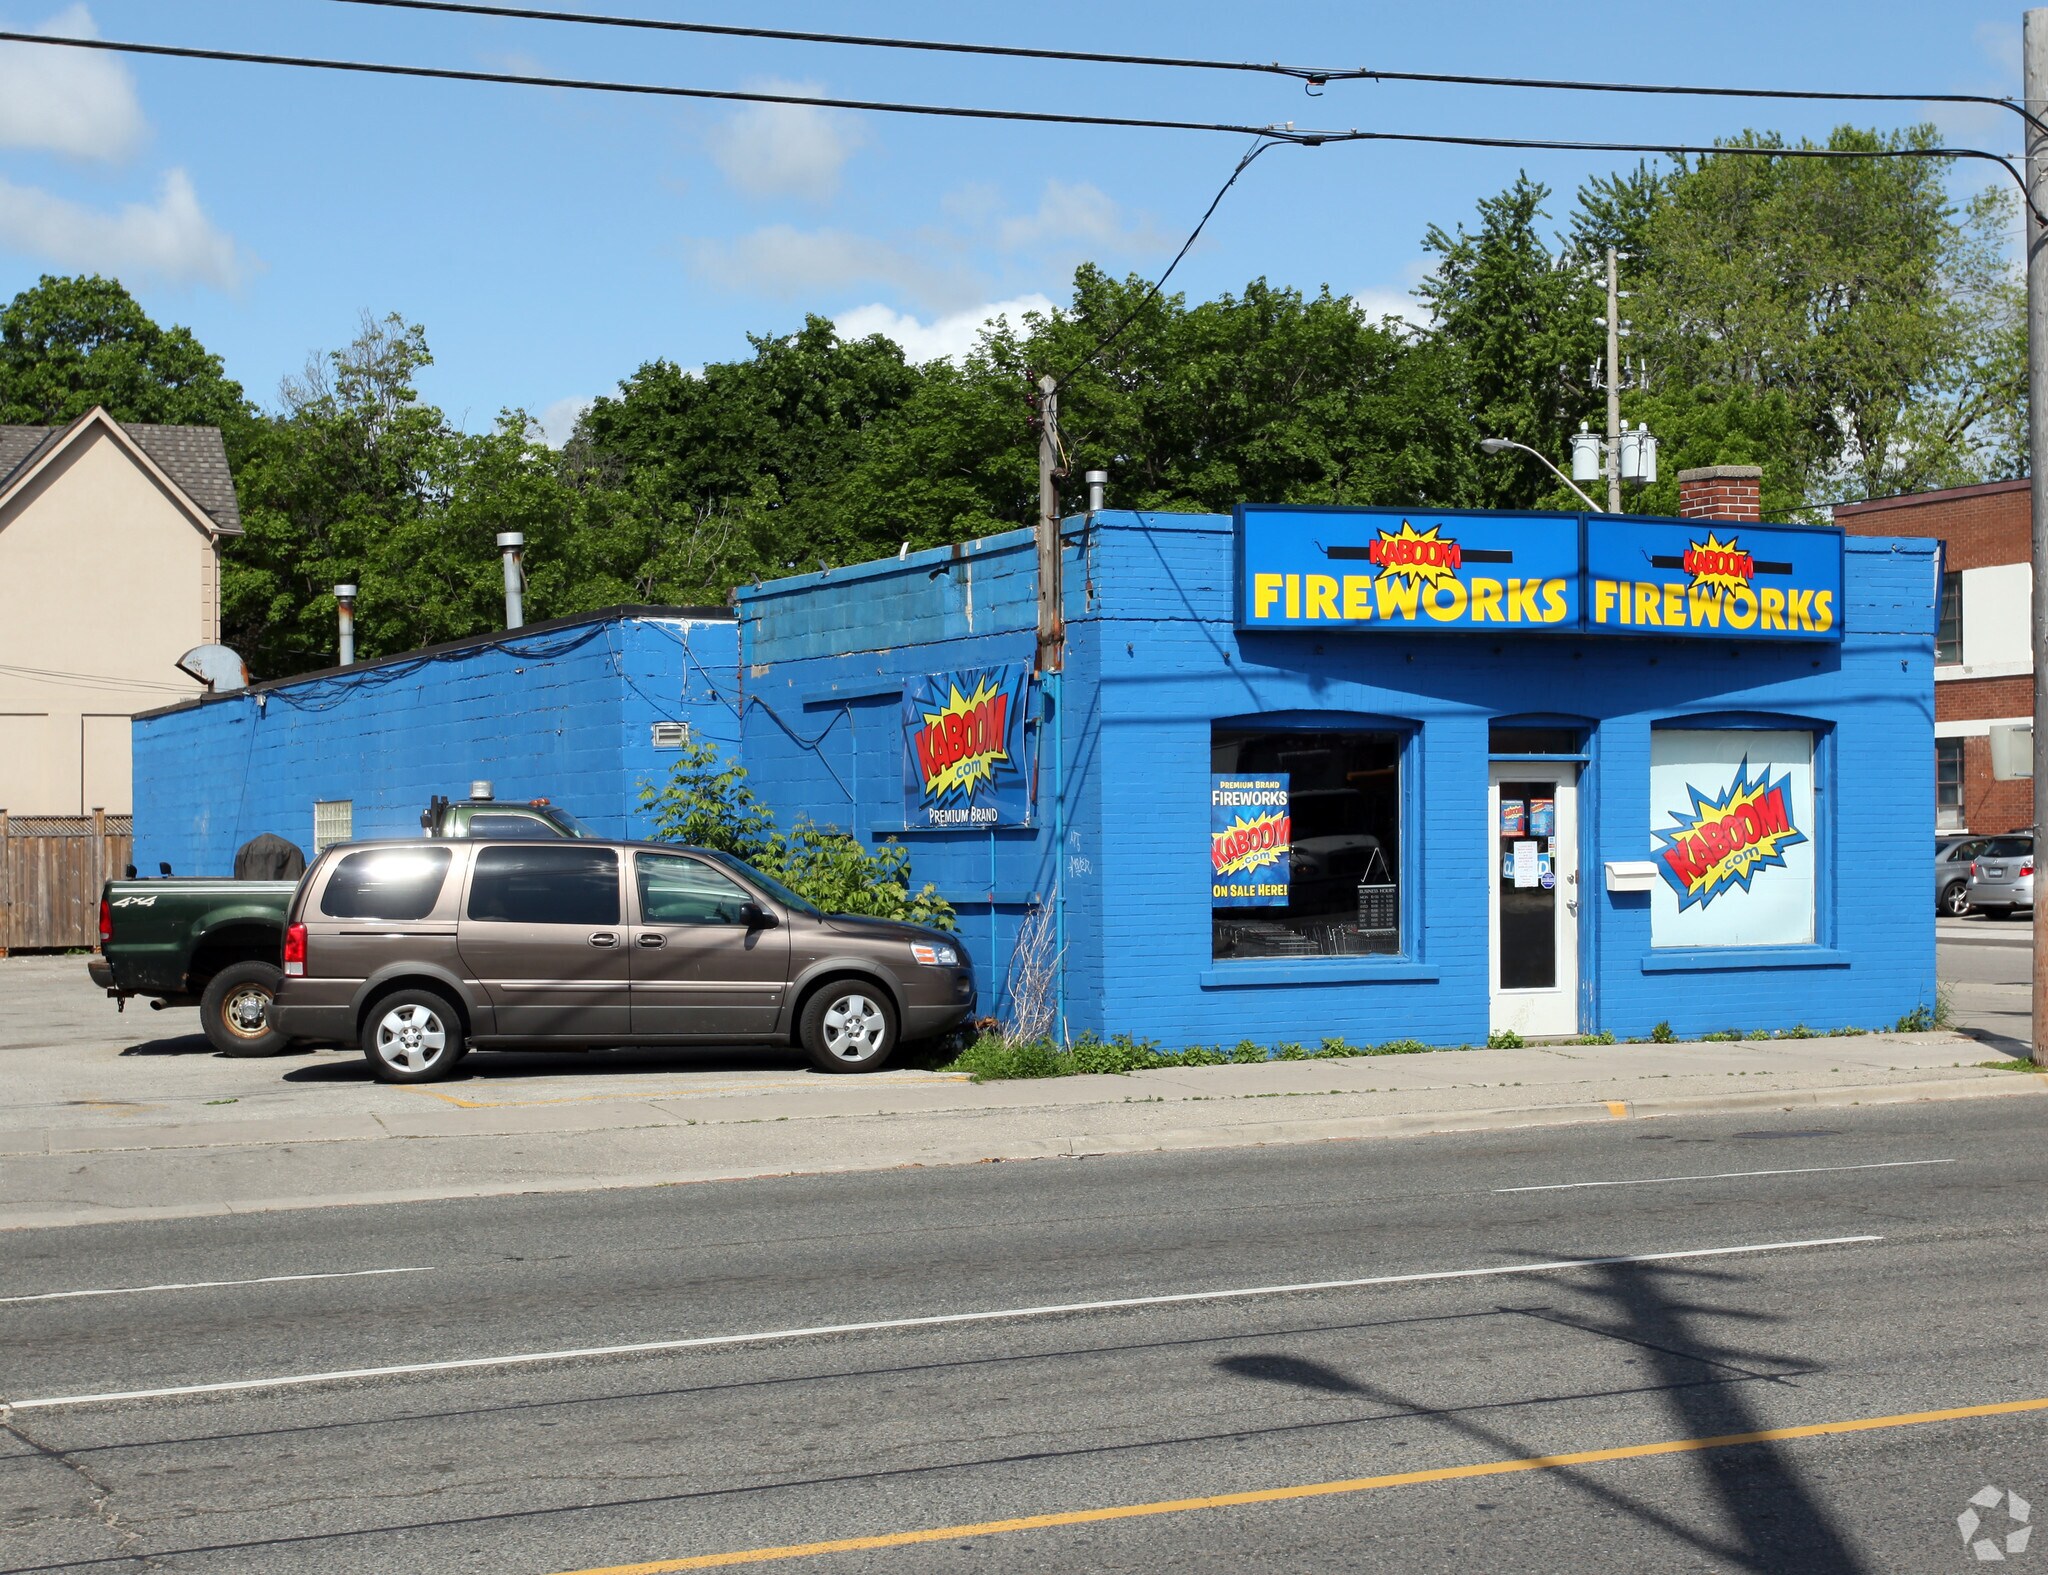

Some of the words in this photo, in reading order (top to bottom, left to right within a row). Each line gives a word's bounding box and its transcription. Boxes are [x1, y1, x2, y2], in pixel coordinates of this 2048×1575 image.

[1369, 539, 1461, 569] KABOOM
[1683, 549, 1754, 579] KABOOM
[1254, 573, 1567, 623] FIREWORKS
[1595, 580, 1833, 632] FIREWORKS
[914, 693, 1008, 783] KABOOM
[954, 760, 981, 781] .com
[1212, 790, 1288, 805] FIREWORKS
[929, 807, 970, 823] PREMIUM
[970, 805, 998, 822] BRAND
[1211, 816, 1291, 870] KABOOM
[1662, 786, 1790, 888] KABOOM
[1242, 851, 1270, 865] .com
[1723, 846, 1760, 873] .com
[112, 895, 158, 907] 4x4
[1213, 884, 1228, 897] ON
[1230, 884, 1256, 896] SALE
[1258, 883, 1288, 896] HERE!
